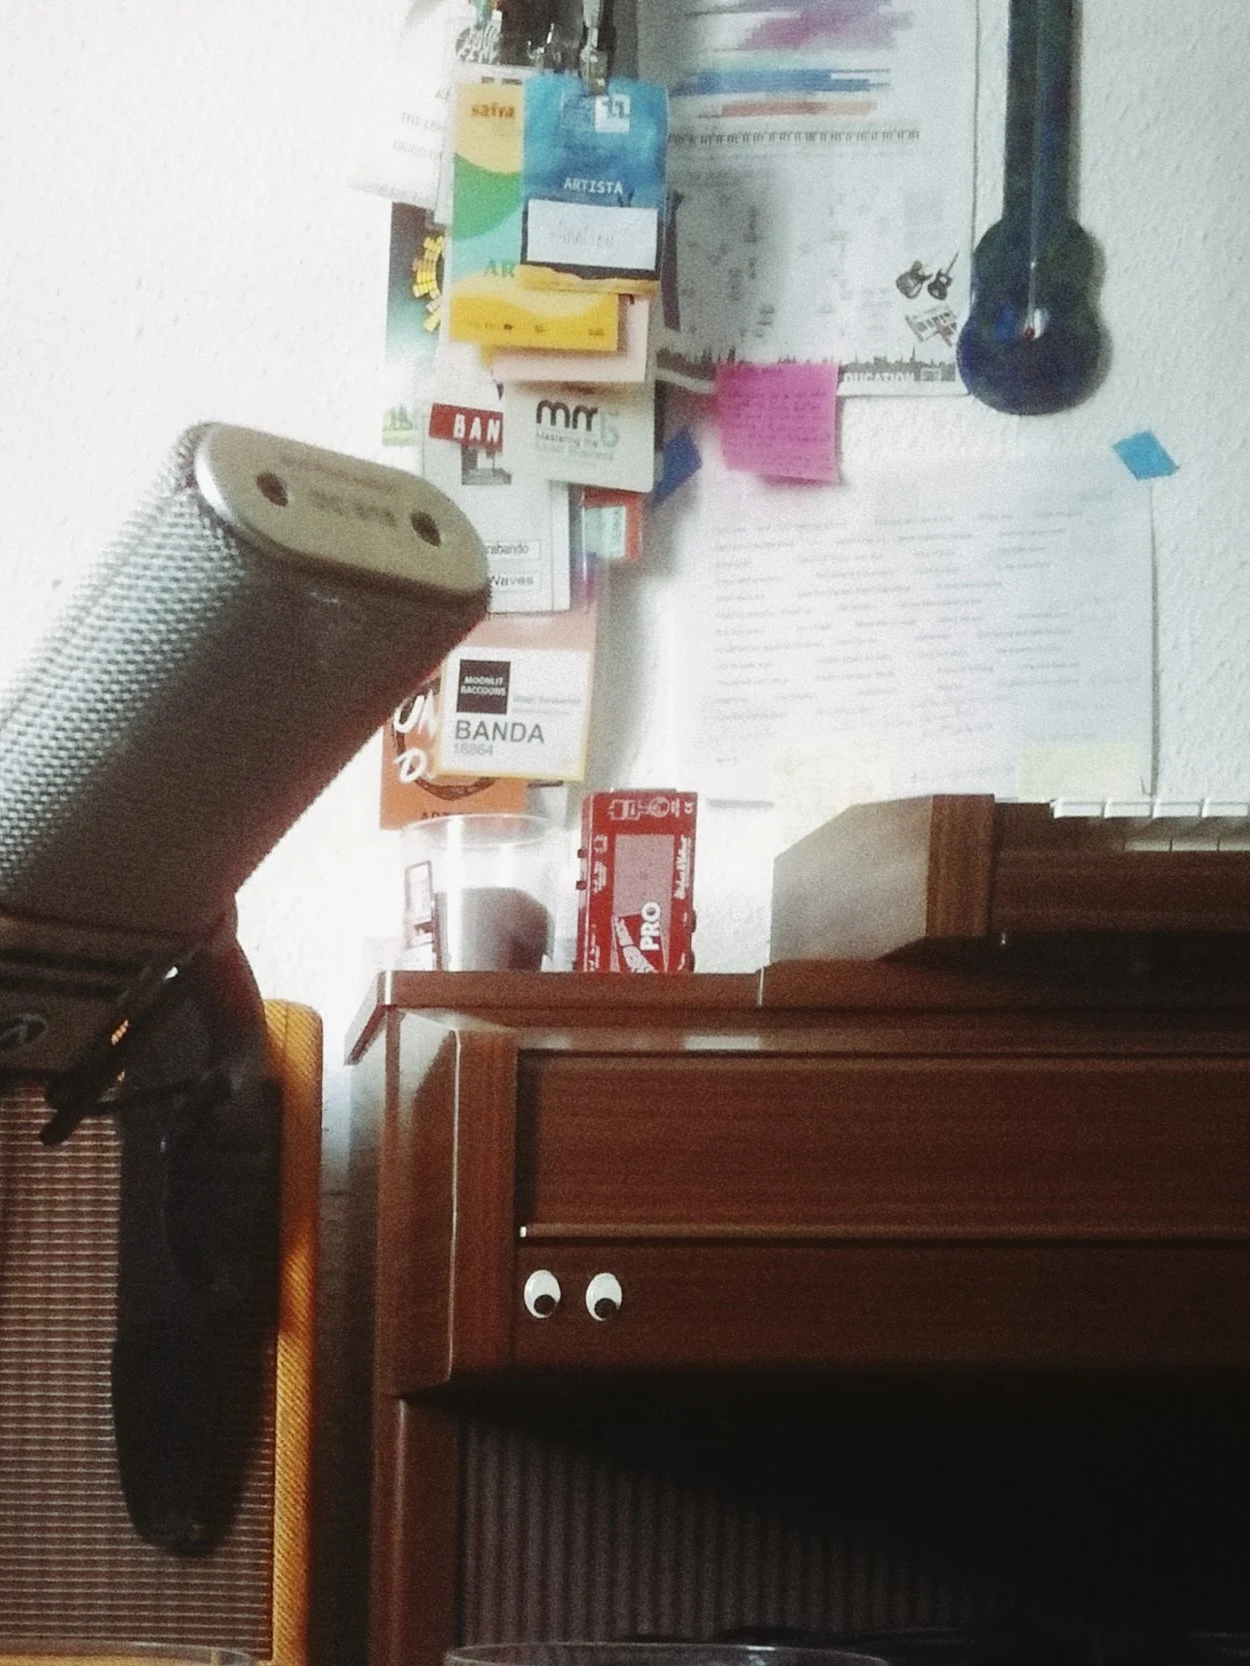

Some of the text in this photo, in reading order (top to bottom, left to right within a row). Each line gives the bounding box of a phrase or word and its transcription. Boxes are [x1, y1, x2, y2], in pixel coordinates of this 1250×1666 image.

[564, 176, 624, 196] ARTISTA
[454, 719, 545, 744] BANDA
[639, 902, 661, 950] PRO
